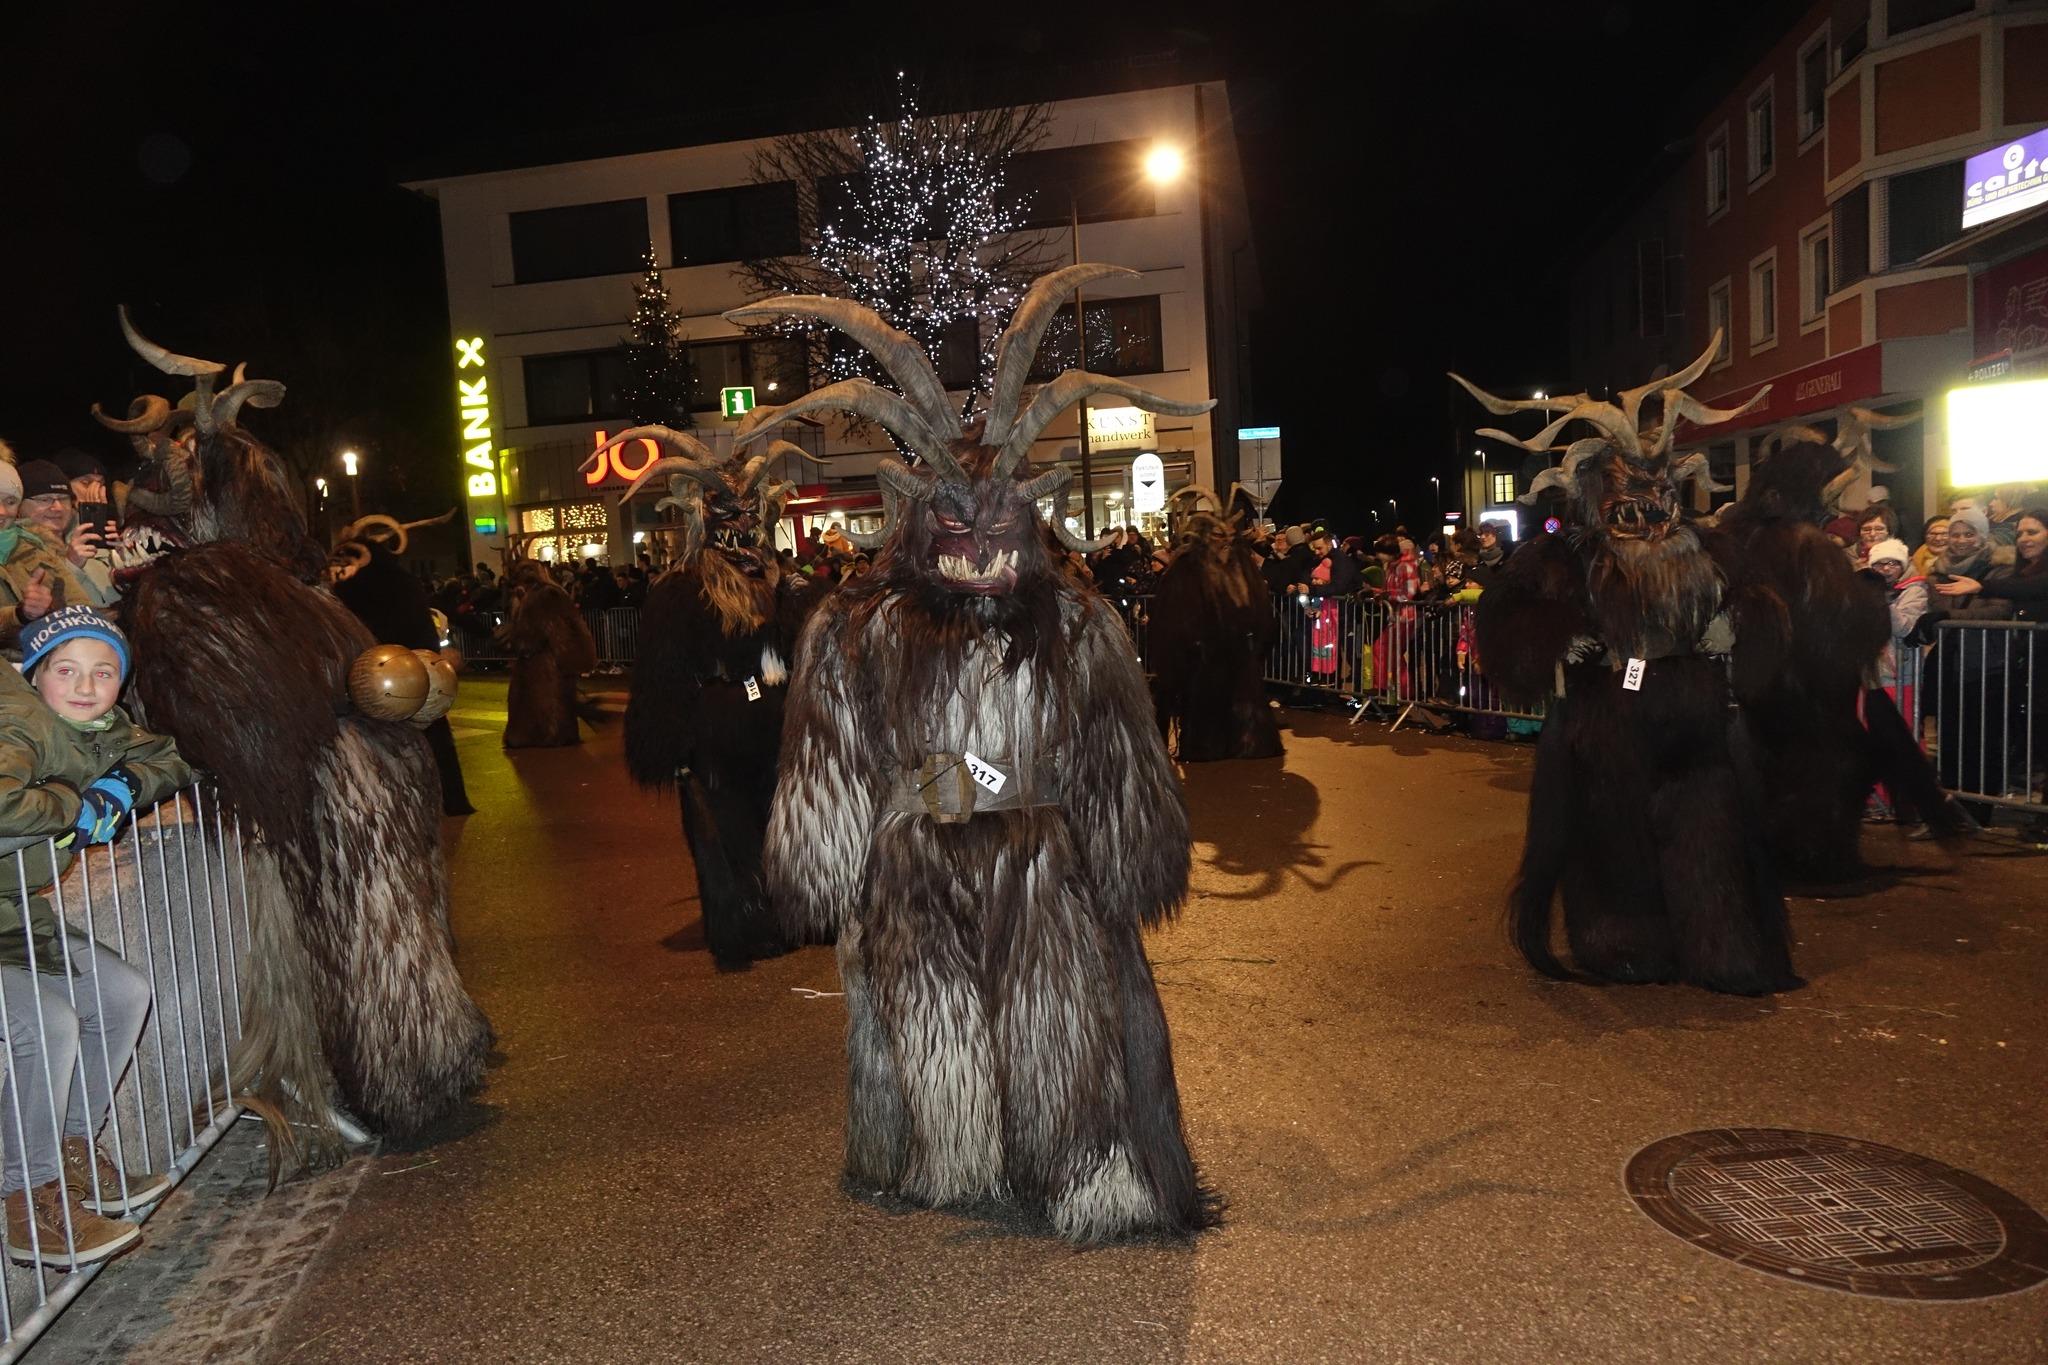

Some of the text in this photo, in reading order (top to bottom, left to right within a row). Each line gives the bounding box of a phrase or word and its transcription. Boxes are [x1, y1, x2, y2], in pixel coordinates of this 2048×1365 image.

[1974, 361, 2006, 381] POLIZEI
[458, 375, 497, 497] BANK
[1627, 665, 1640, 687] 327
[747, 681, 759, 698] 316
[970, 763, 997, 786] 317
